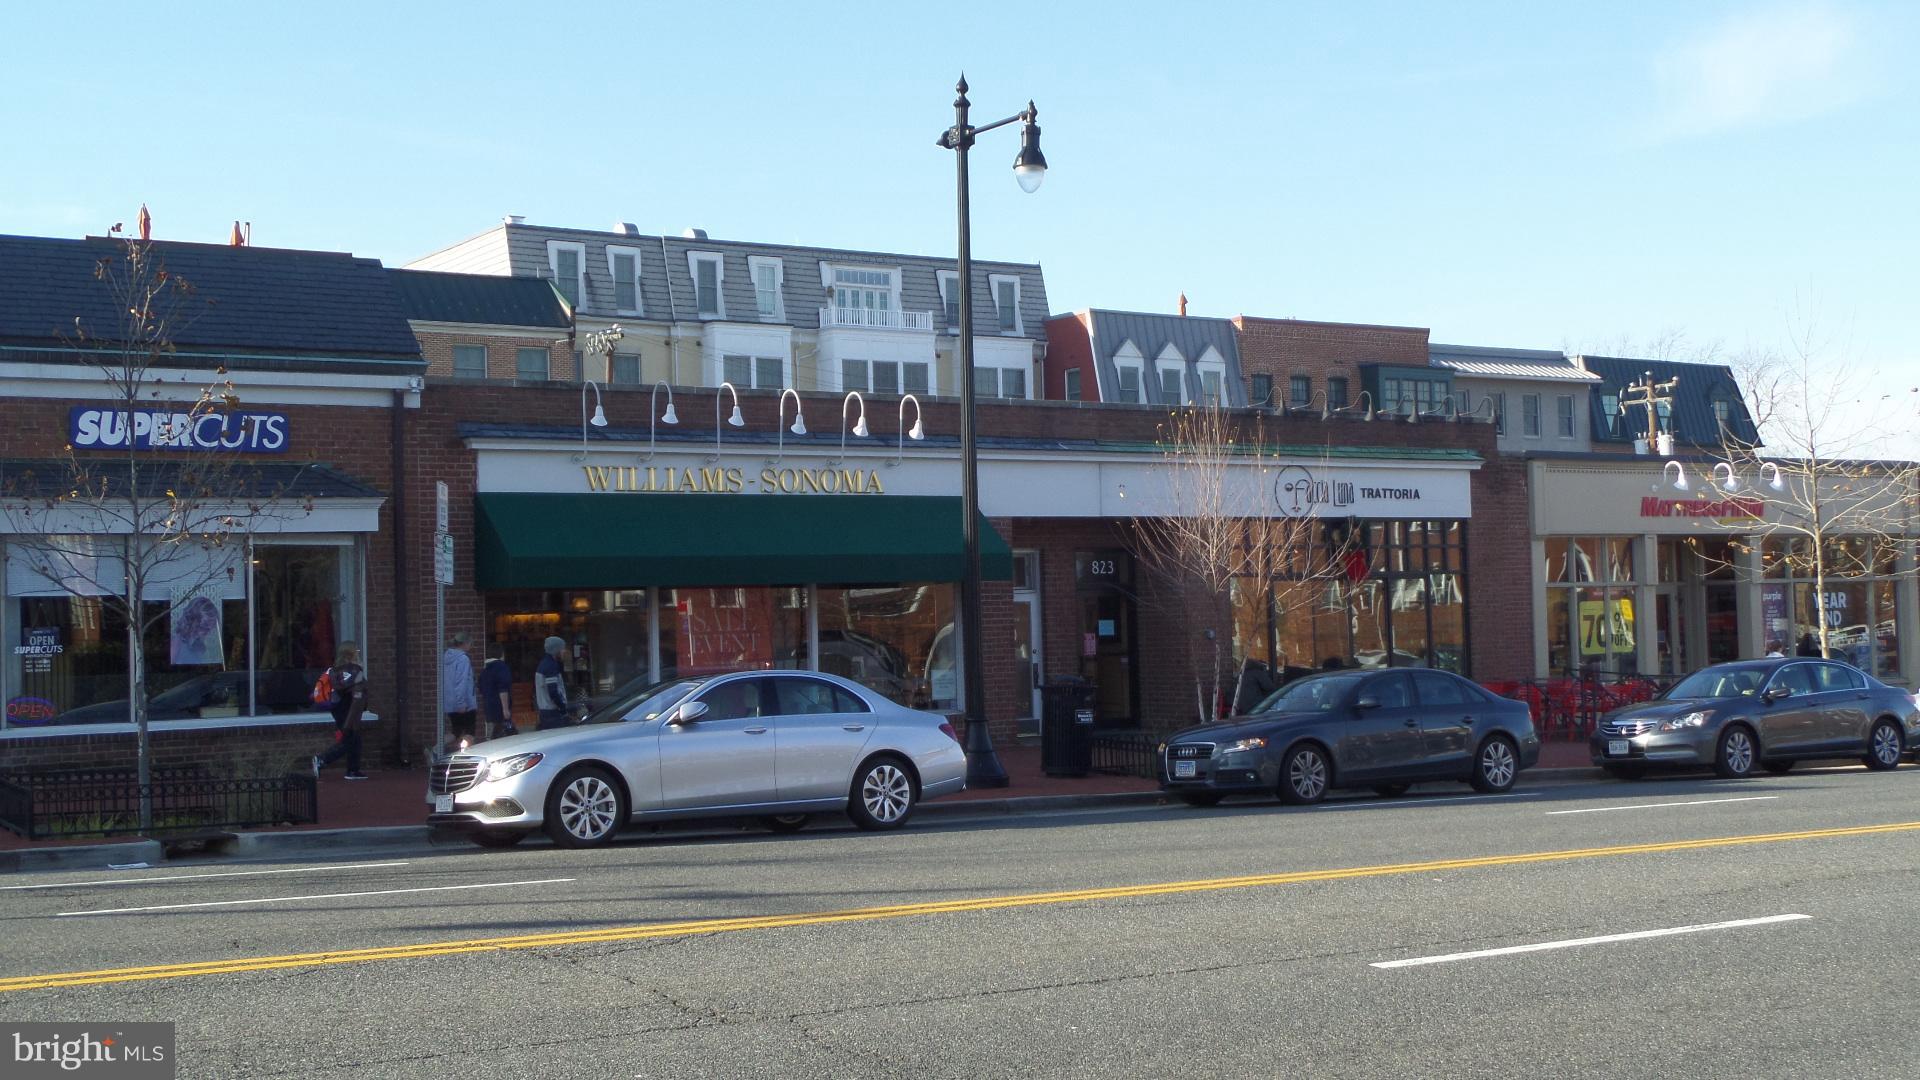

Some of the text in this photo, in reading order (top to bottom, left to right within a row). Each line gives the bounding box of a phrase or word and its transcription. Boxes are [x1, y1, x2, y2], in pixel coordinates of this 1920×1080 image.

[75, 410, 285, 449] SUPERCUTS
[1360, 487, 1420, 500] TRATTORIA
[1091, 560, 1114, 574] 823
[1762, 591, 1782, 601] purple
[30, 636, 55, 646] OPEN
[14, 645, 63, 655] SUPERCUTS
[7, 703, 55, 718] OPEN
